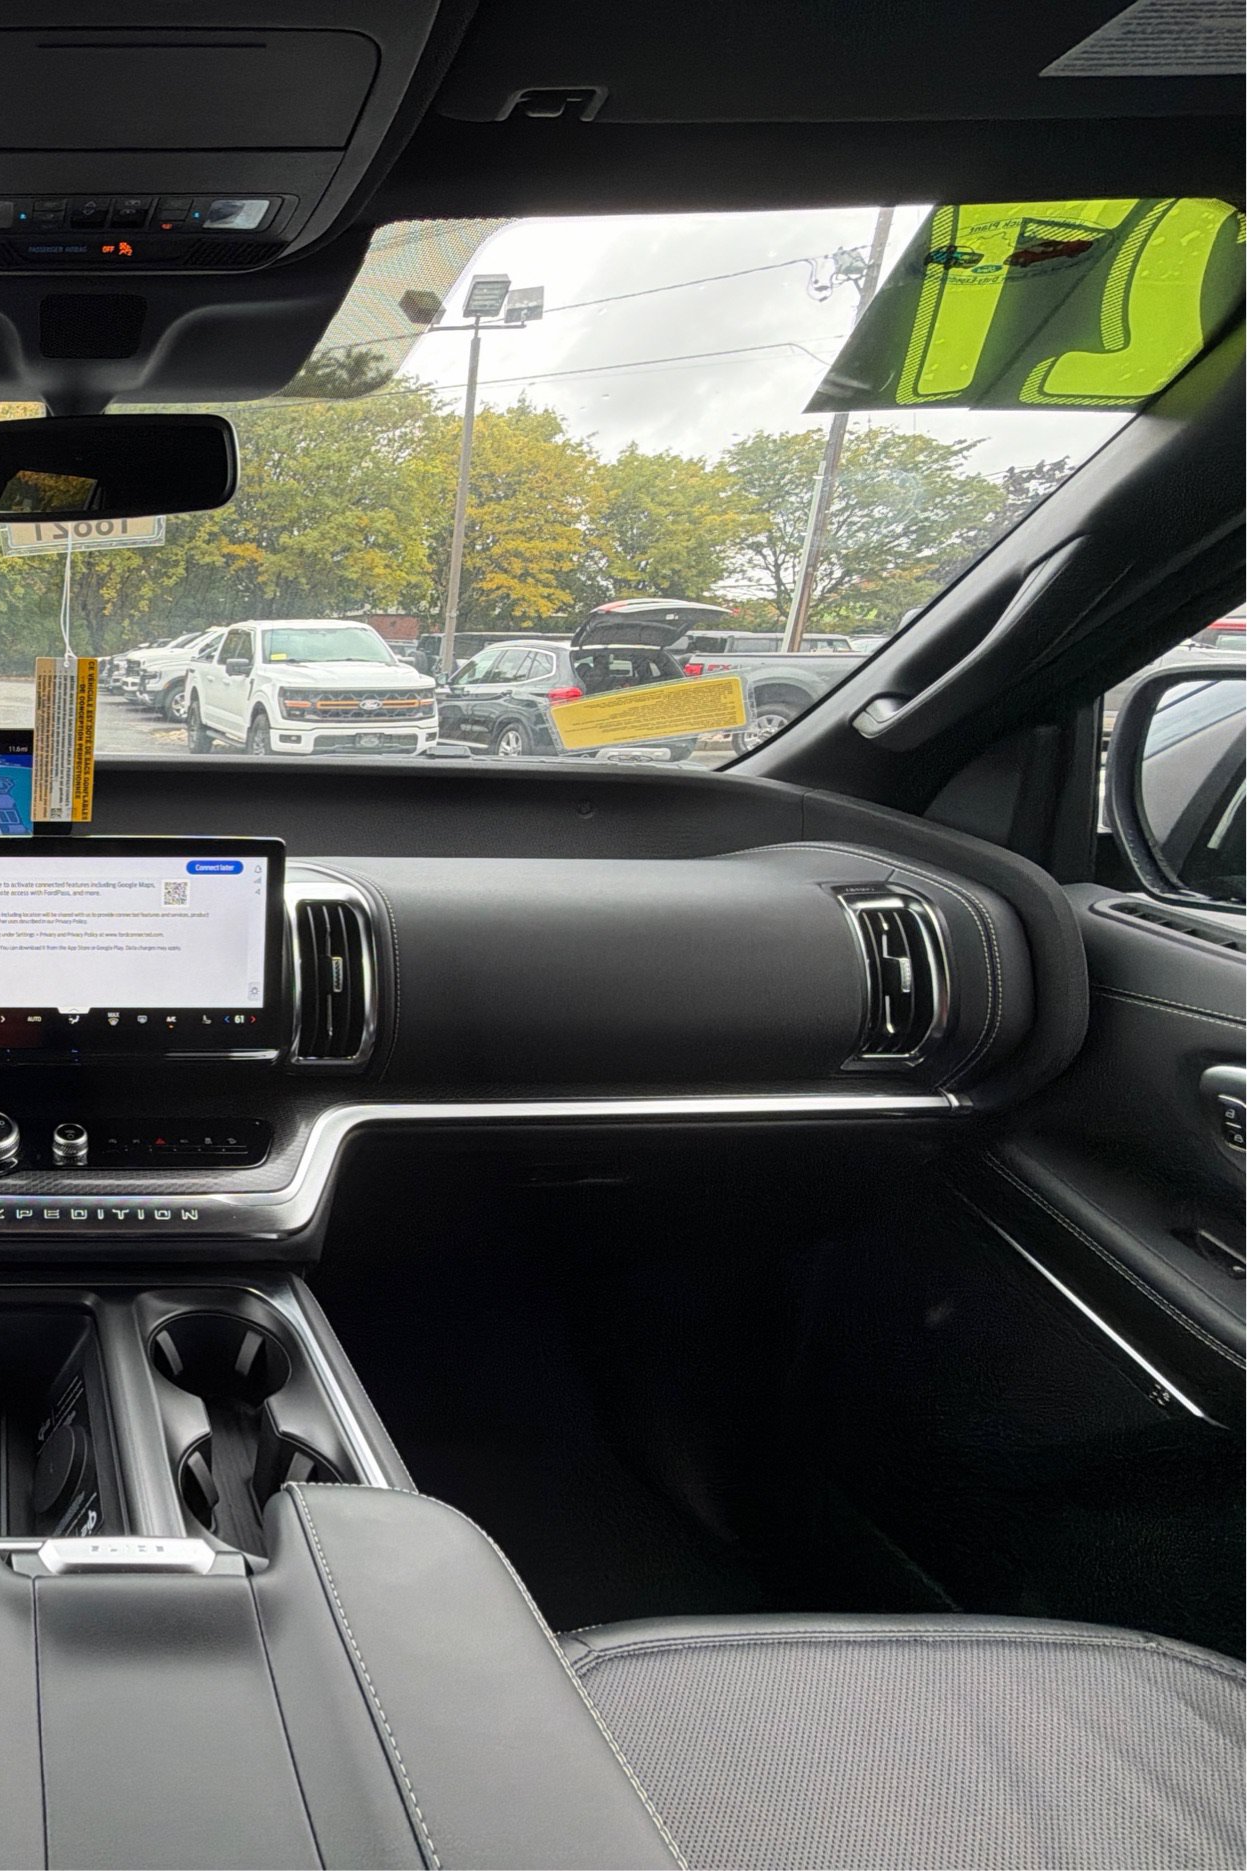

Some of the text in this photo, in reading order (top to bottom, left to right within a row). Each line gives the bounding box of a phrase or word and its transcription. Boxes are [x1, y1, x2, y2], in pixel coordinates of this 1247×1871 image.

[102, 245, 115, 254] OFF
[88, 661, 95, 671] CE
[79, 683, 86, 694] DE
[77, 695, 85, 741] CONCEPTION
[86, 710, 94, 723] EST
[84, 746, 91, 756] DE
[83, 757, 91, 776] SACS
[81, 776, 89, 821] GONFLABLES
[195, 863, 235, 872] Connect later
[3, 881, 10, 889] to
[10, 881, 34, 889] activate
[35, 881, 65, 889] connected
[66, 881, 90, 889] features
[90, 881, 116, 889] including
[118, 881, 138, 889] Google
[10, 889, 29, 897] access
[30, 889, 42, 897] with
[72, 889, 84, 897] and
[27, 1015, 42, 1023] AUTO
[234, 1015, 245, 1023] 61
